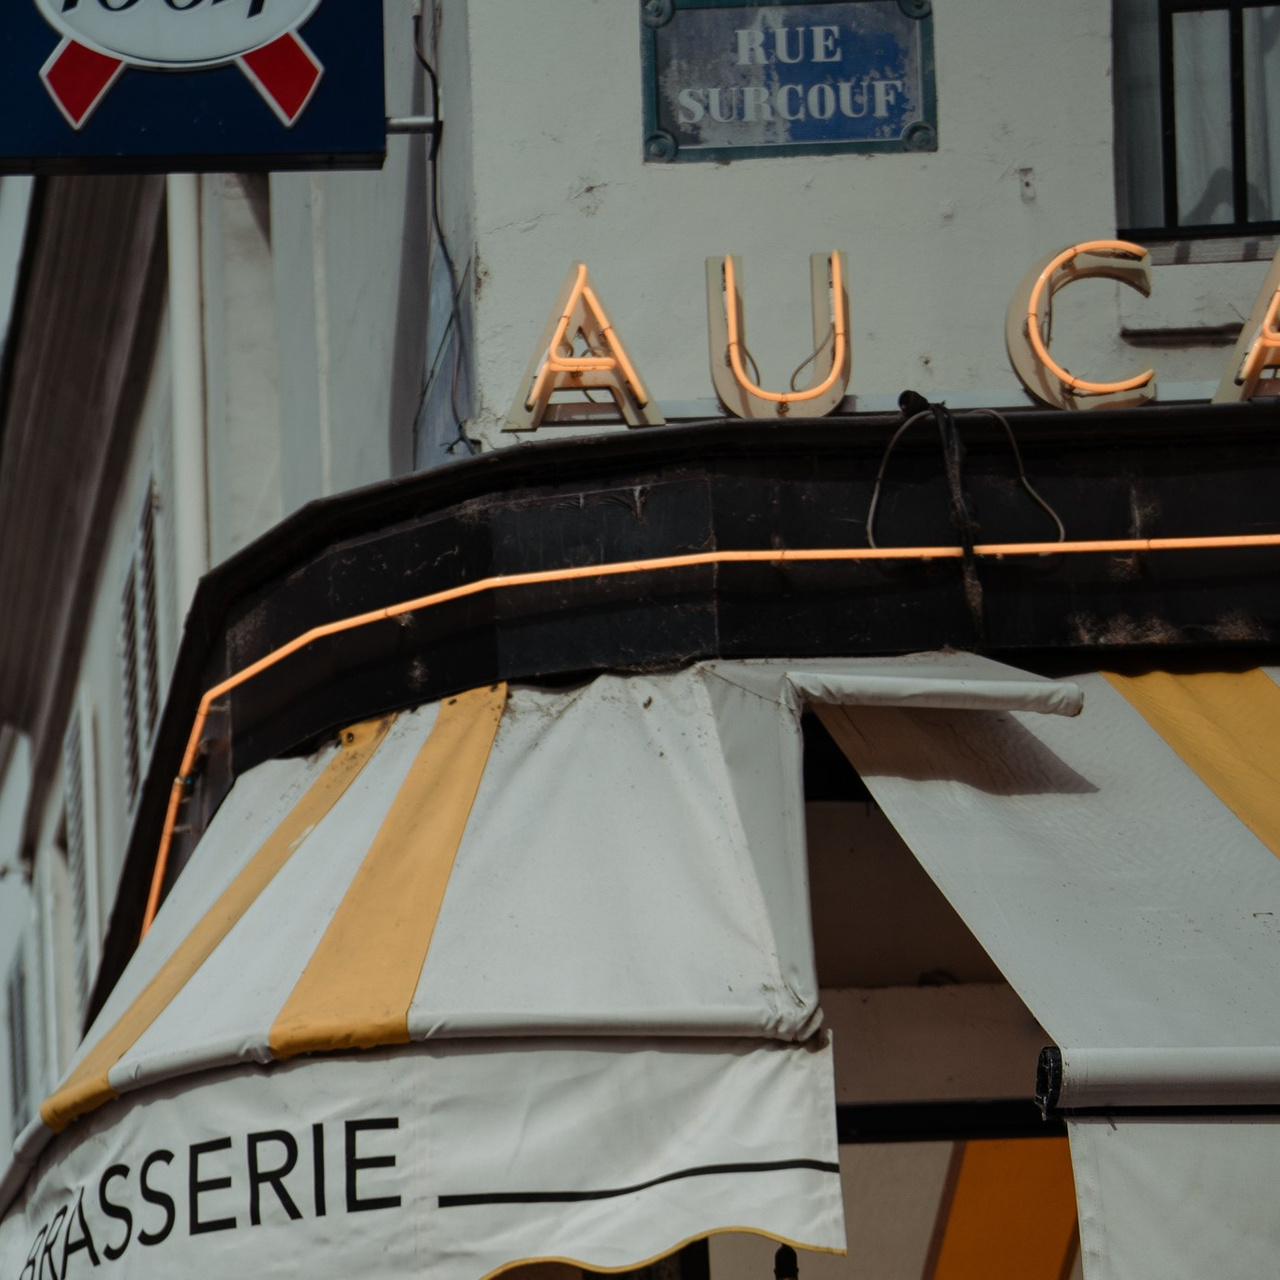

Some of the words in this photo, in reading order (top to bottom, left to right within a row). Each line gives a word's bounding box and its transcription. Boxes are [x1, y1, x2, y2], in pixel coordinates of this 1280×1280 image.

[735, 25, 842, 66] RUE
[677, 80, 903, 124] SURCOUF
[502, 248, 852, 431] AU
